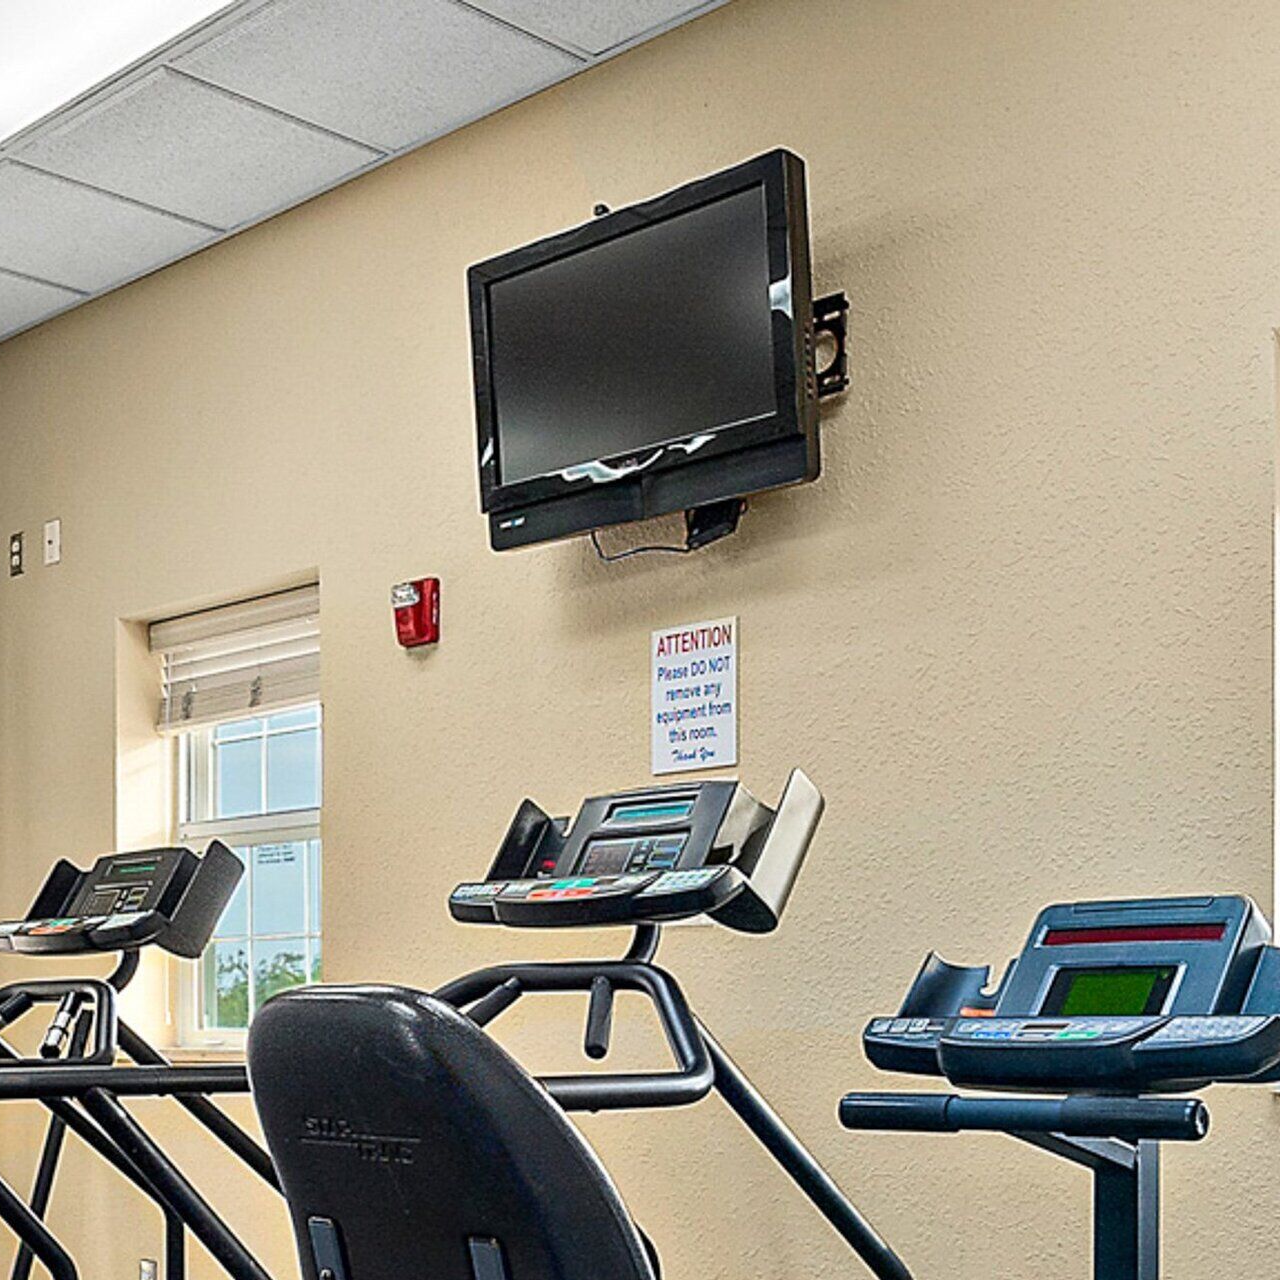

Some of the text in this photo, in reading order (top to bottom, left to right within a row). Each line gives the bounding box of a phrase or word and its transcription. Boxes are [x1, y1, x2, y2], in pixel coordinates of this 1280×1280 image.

[657, 624, 732, 657] ATTENTION
[658, 656, 731, 682] Please DO NOT
[666, 682, 722, 701] remove any
[657, 702, 732, 725] equipment from
[669, 728, 687, 743] this
